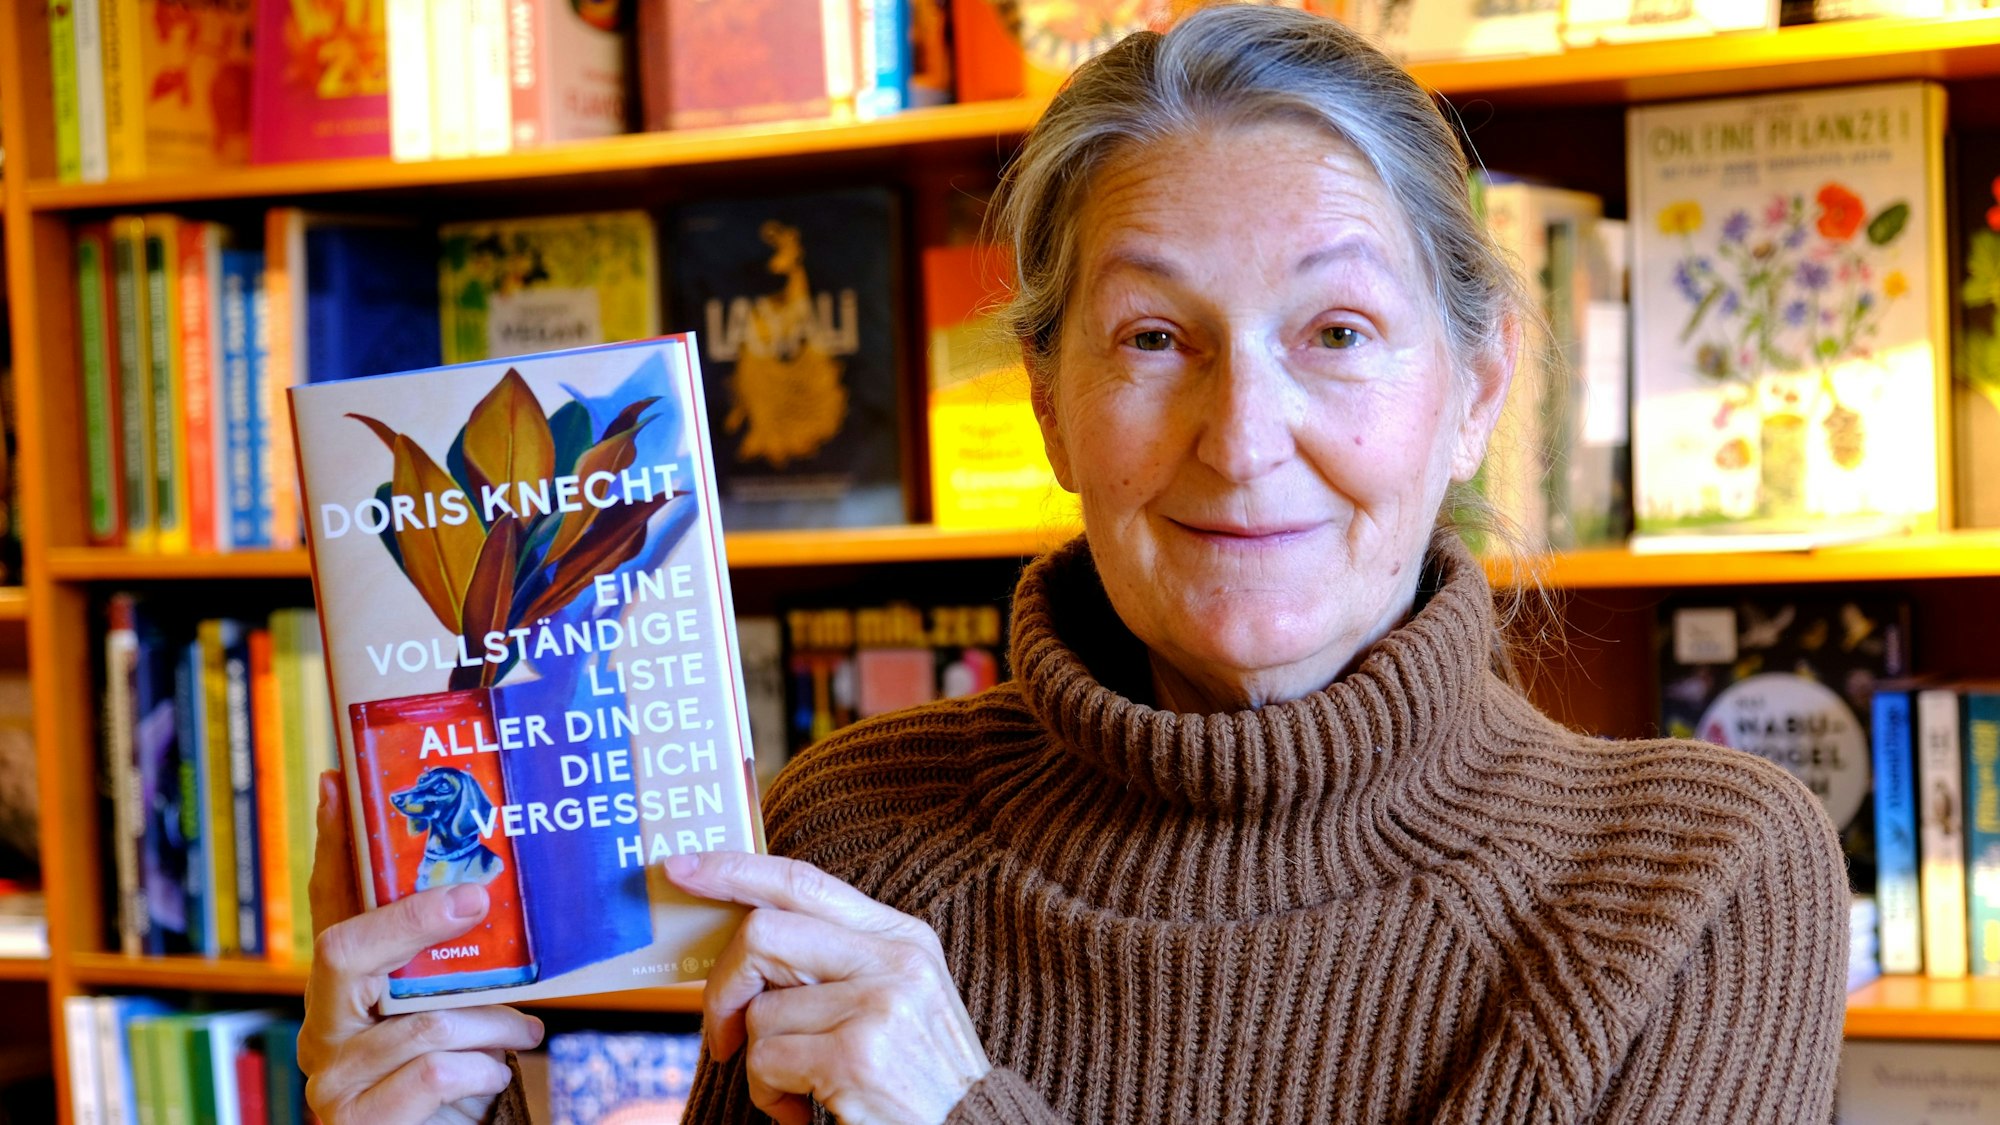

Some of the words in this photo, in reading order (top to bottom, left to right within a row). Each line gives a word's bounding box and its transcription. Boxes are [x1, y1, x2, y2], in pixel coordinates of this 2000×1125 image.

[320, 488, 468, 539] DORIS
[481, 463, 679, 523] KNECHT
[594, 565, 694, 607] EINE
[366, 609, 700, 676] VOLLSTÄNDIGE
[589, 653, 706, 697] LISTE
[419, 714, 555, 760] ALLER
[565, 697, 715, 743] DINGE,
[560, 749, 631, 788] DIE
[642, 739, 718, 778] ICH
[470, 783, 725, 839] VERGESSEN
[430, 944, 480, 961] ROMAN
[632, 963, 678, 975] HANSER
